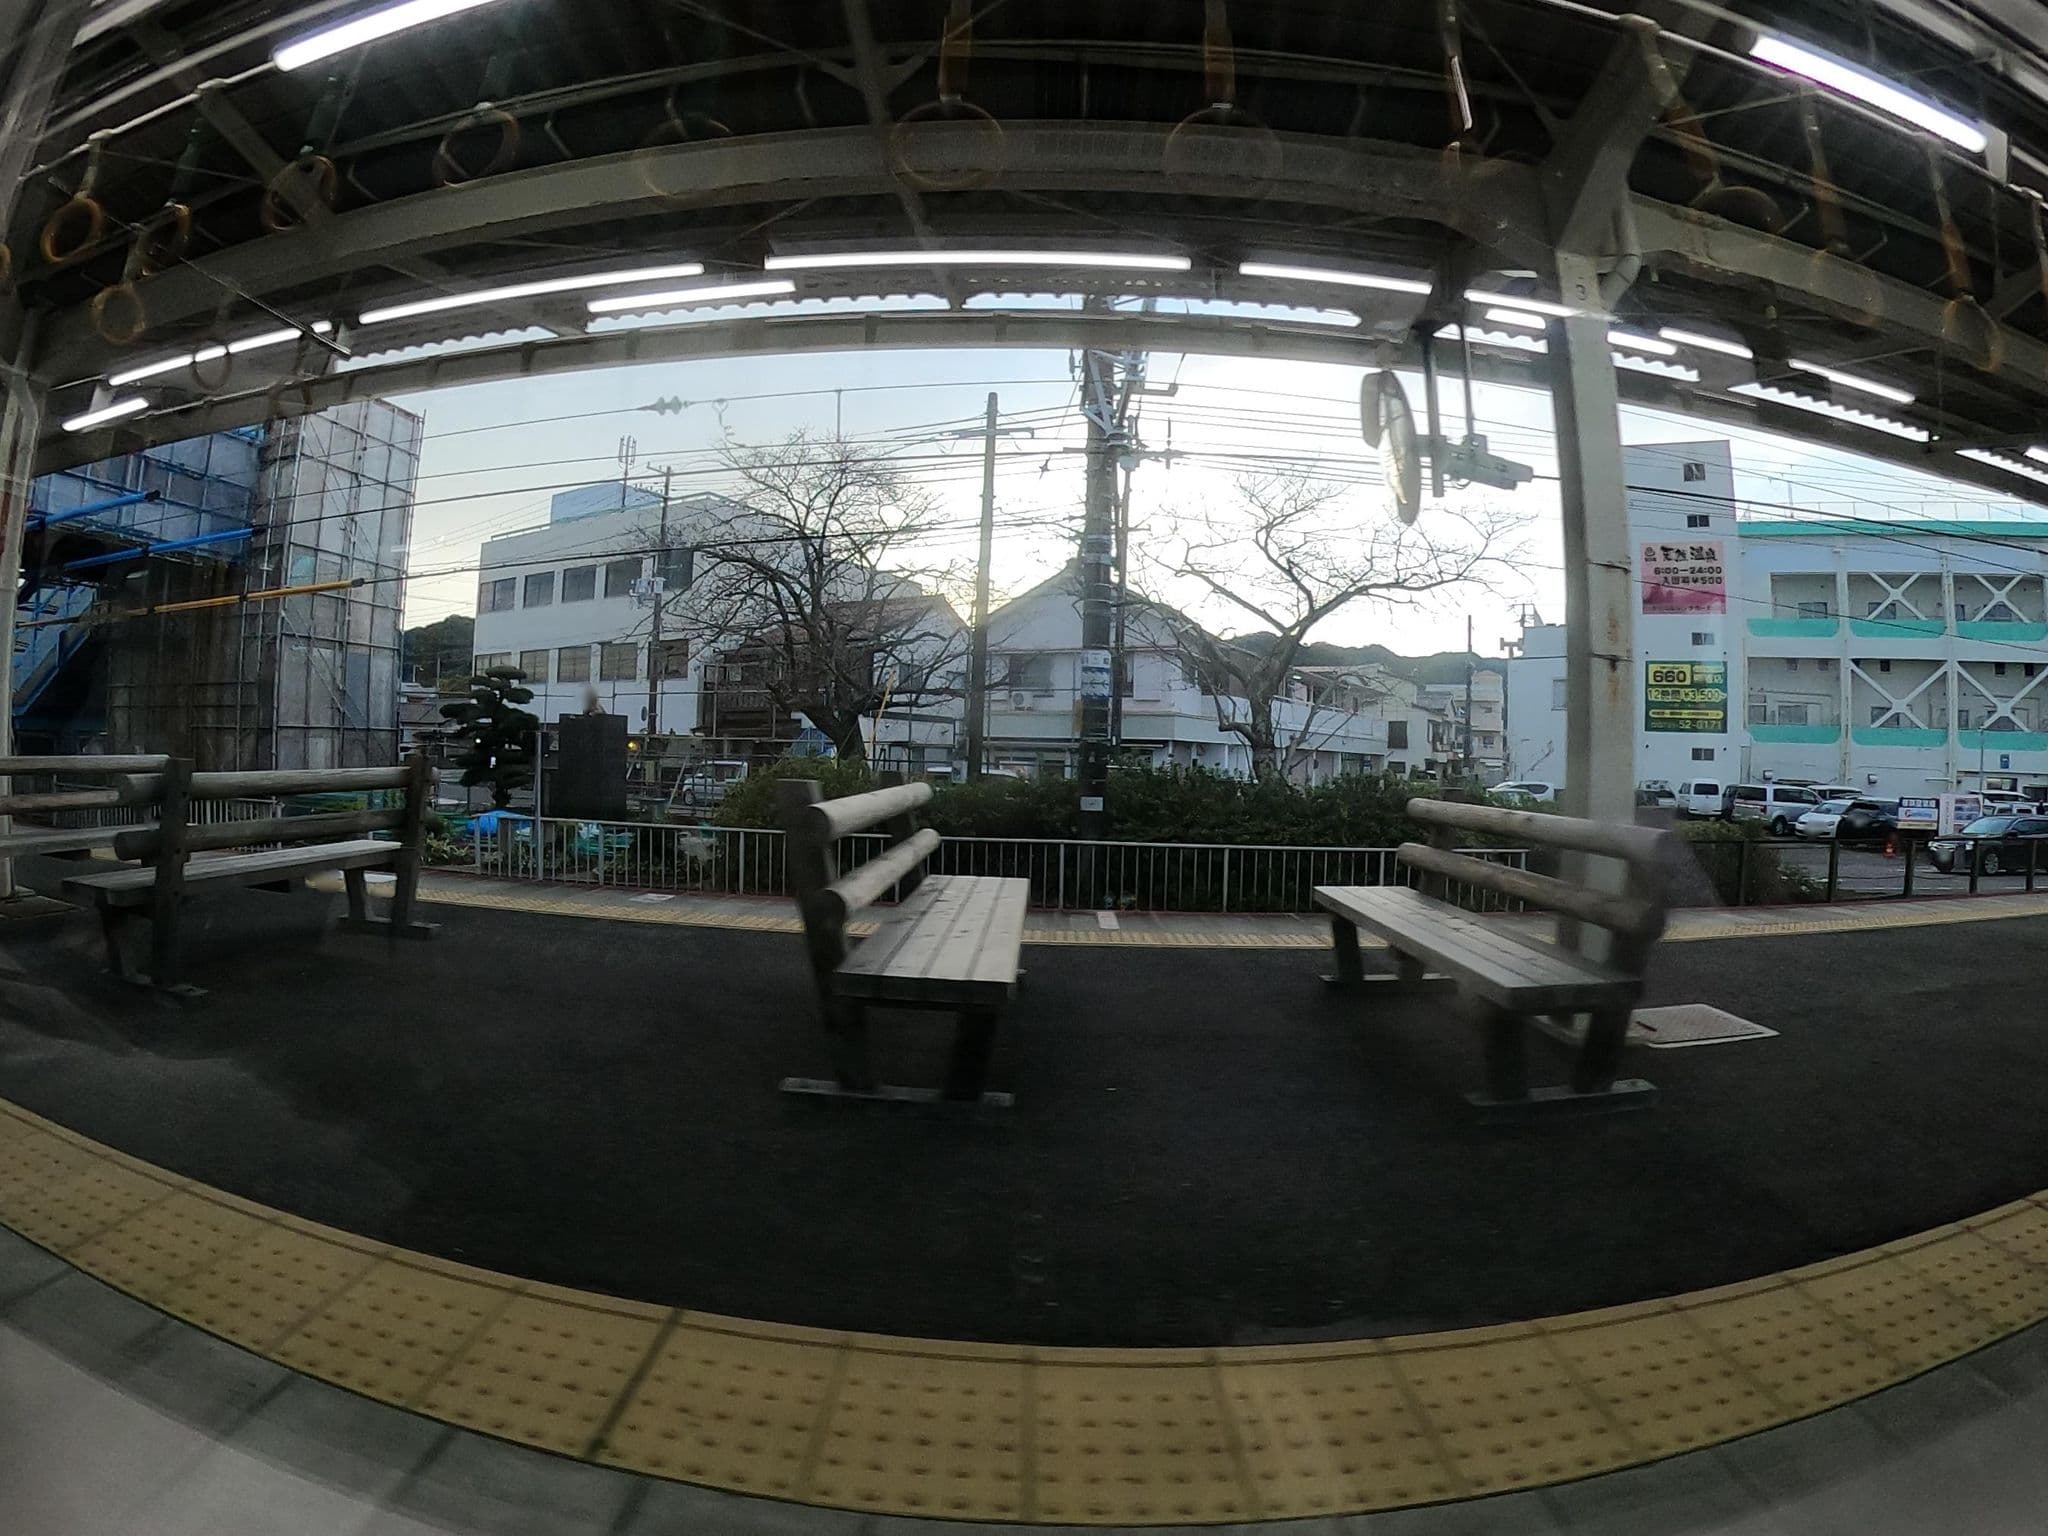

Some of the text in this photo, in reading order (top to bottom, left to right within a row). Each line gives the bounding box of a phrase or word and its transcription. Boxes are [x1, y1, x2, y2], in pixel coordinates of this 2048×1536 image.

[1660, 546, 1718, 562] 天然温泉
[1653, 670, 1686, 682] 660
